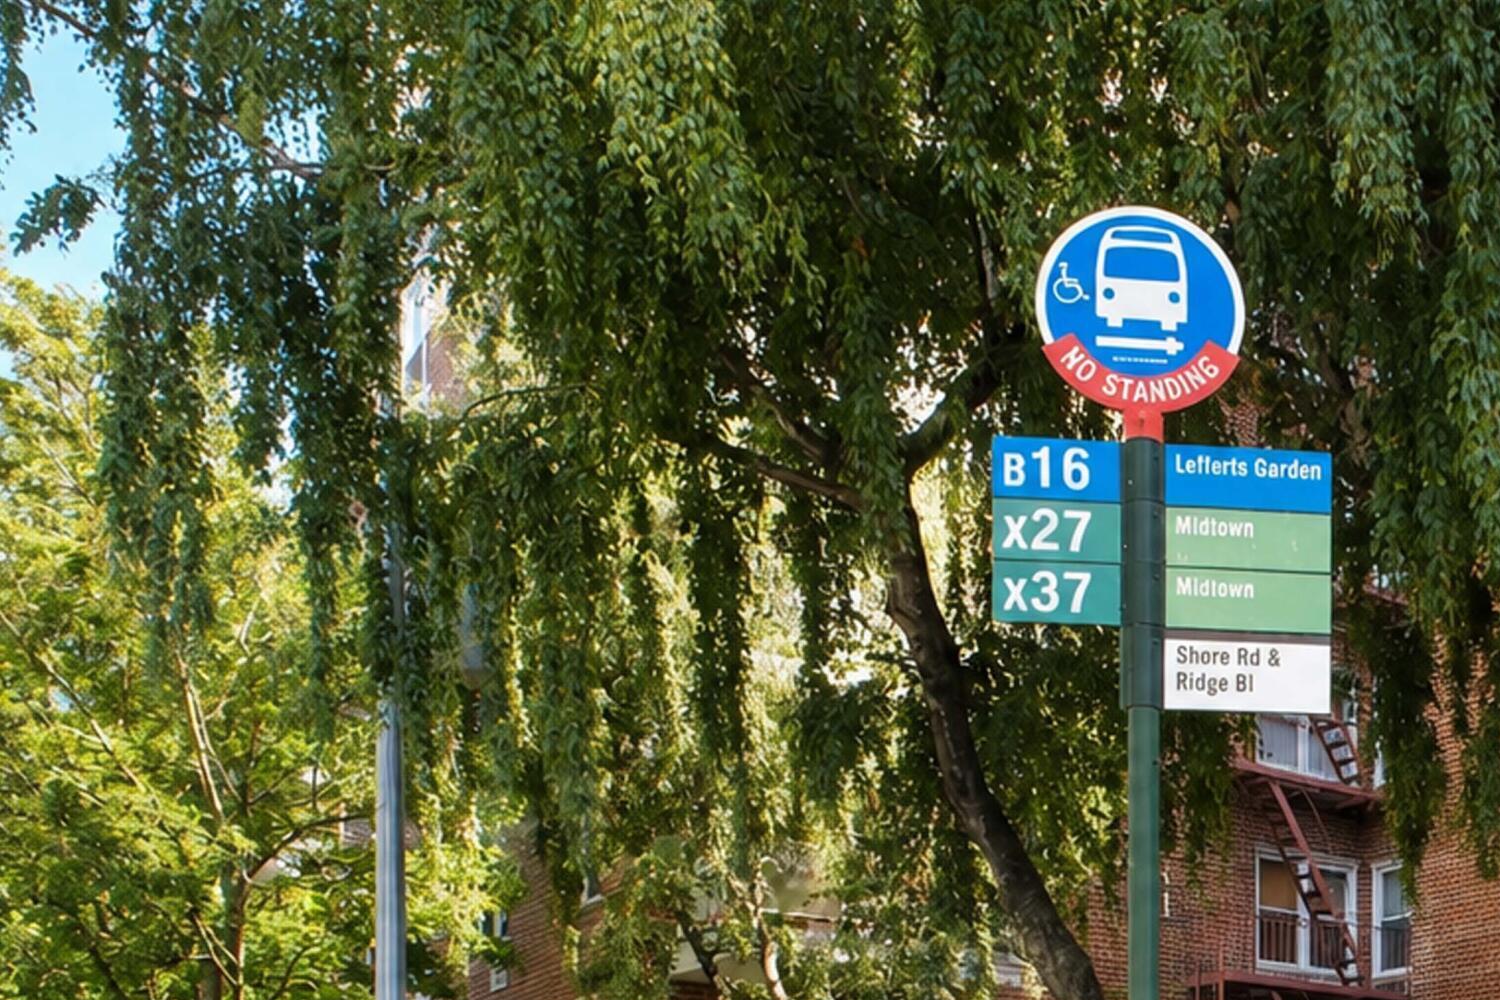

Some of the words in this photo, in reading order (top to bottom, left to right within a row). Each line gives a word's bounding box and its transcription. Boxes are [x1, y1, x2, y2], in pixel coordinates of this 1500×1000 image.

[1060, 345, 1097, 382] NO
[1102, 355, 1220, 404] STANDING
[1003, 445, 1090, 490] B16
[1175, 453, 1248, 477] Lefferts
[1254, 457, 1322, 480] Garden
[1175, 515, 1254, 538] Midtown
[1175, 576, 1255, 599] Midtown
[1176, 645, 1230, 666] Shore
[1237, 647, 1260, 666] Rd
[1267, 648, 1281, 667] &
[1176, 671, 1229, 696] Ridge
[1236, 673, 1254, 692] Bl
